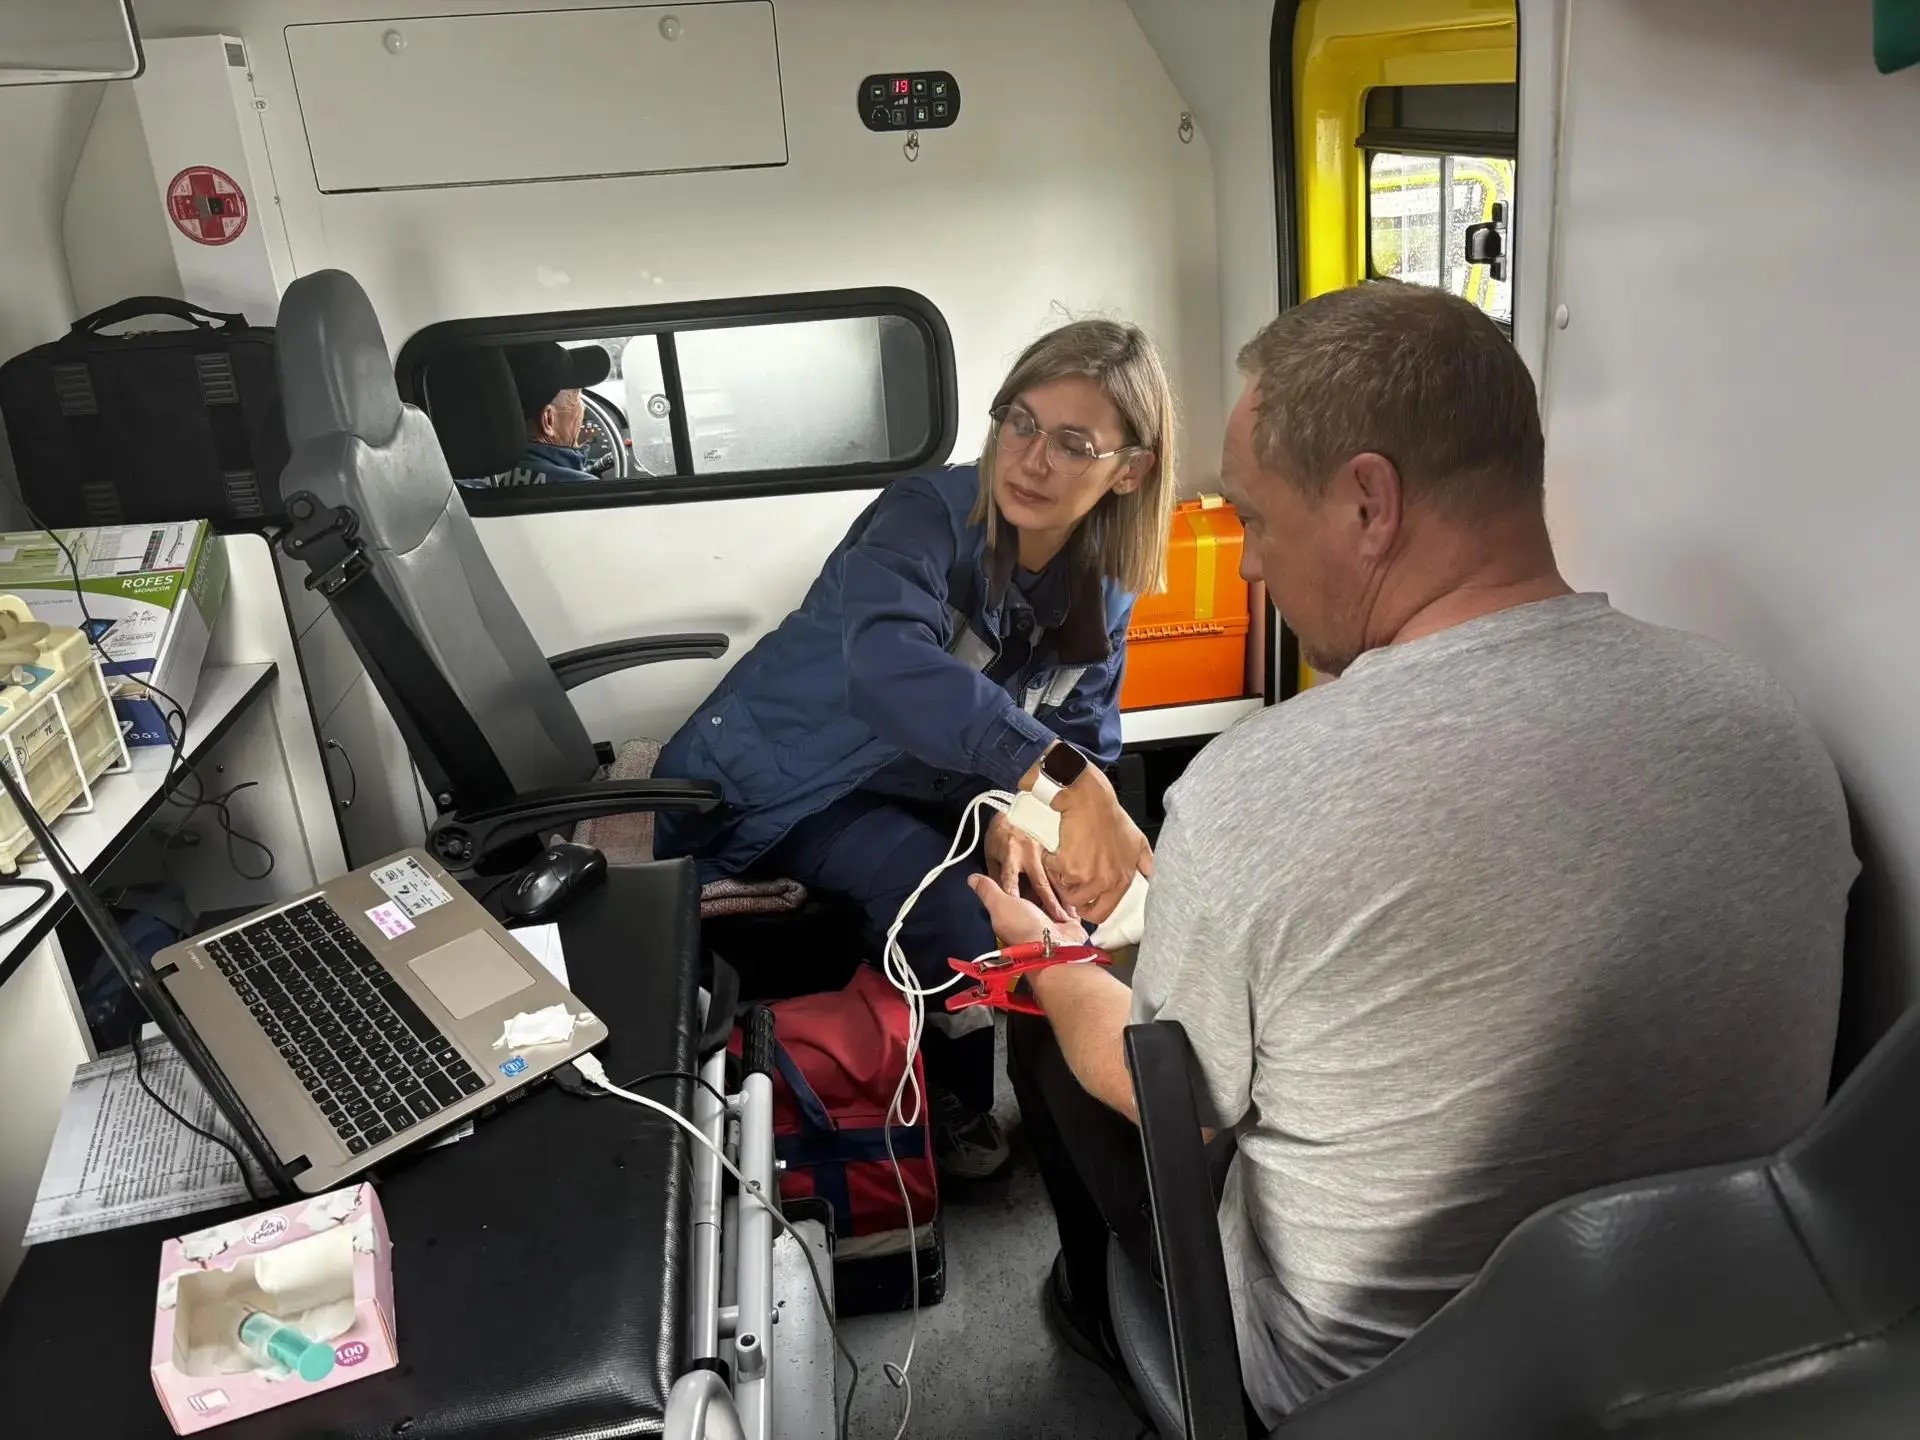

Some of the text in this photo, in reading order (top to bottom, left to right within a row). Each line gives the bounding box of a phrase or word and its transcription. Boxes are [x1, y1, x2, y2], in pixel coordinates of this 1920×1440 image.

[895, 80, 908, 94] 19
[121, 575, 174, 589] ROFES
[335, 1343, 364, 1361] 100
